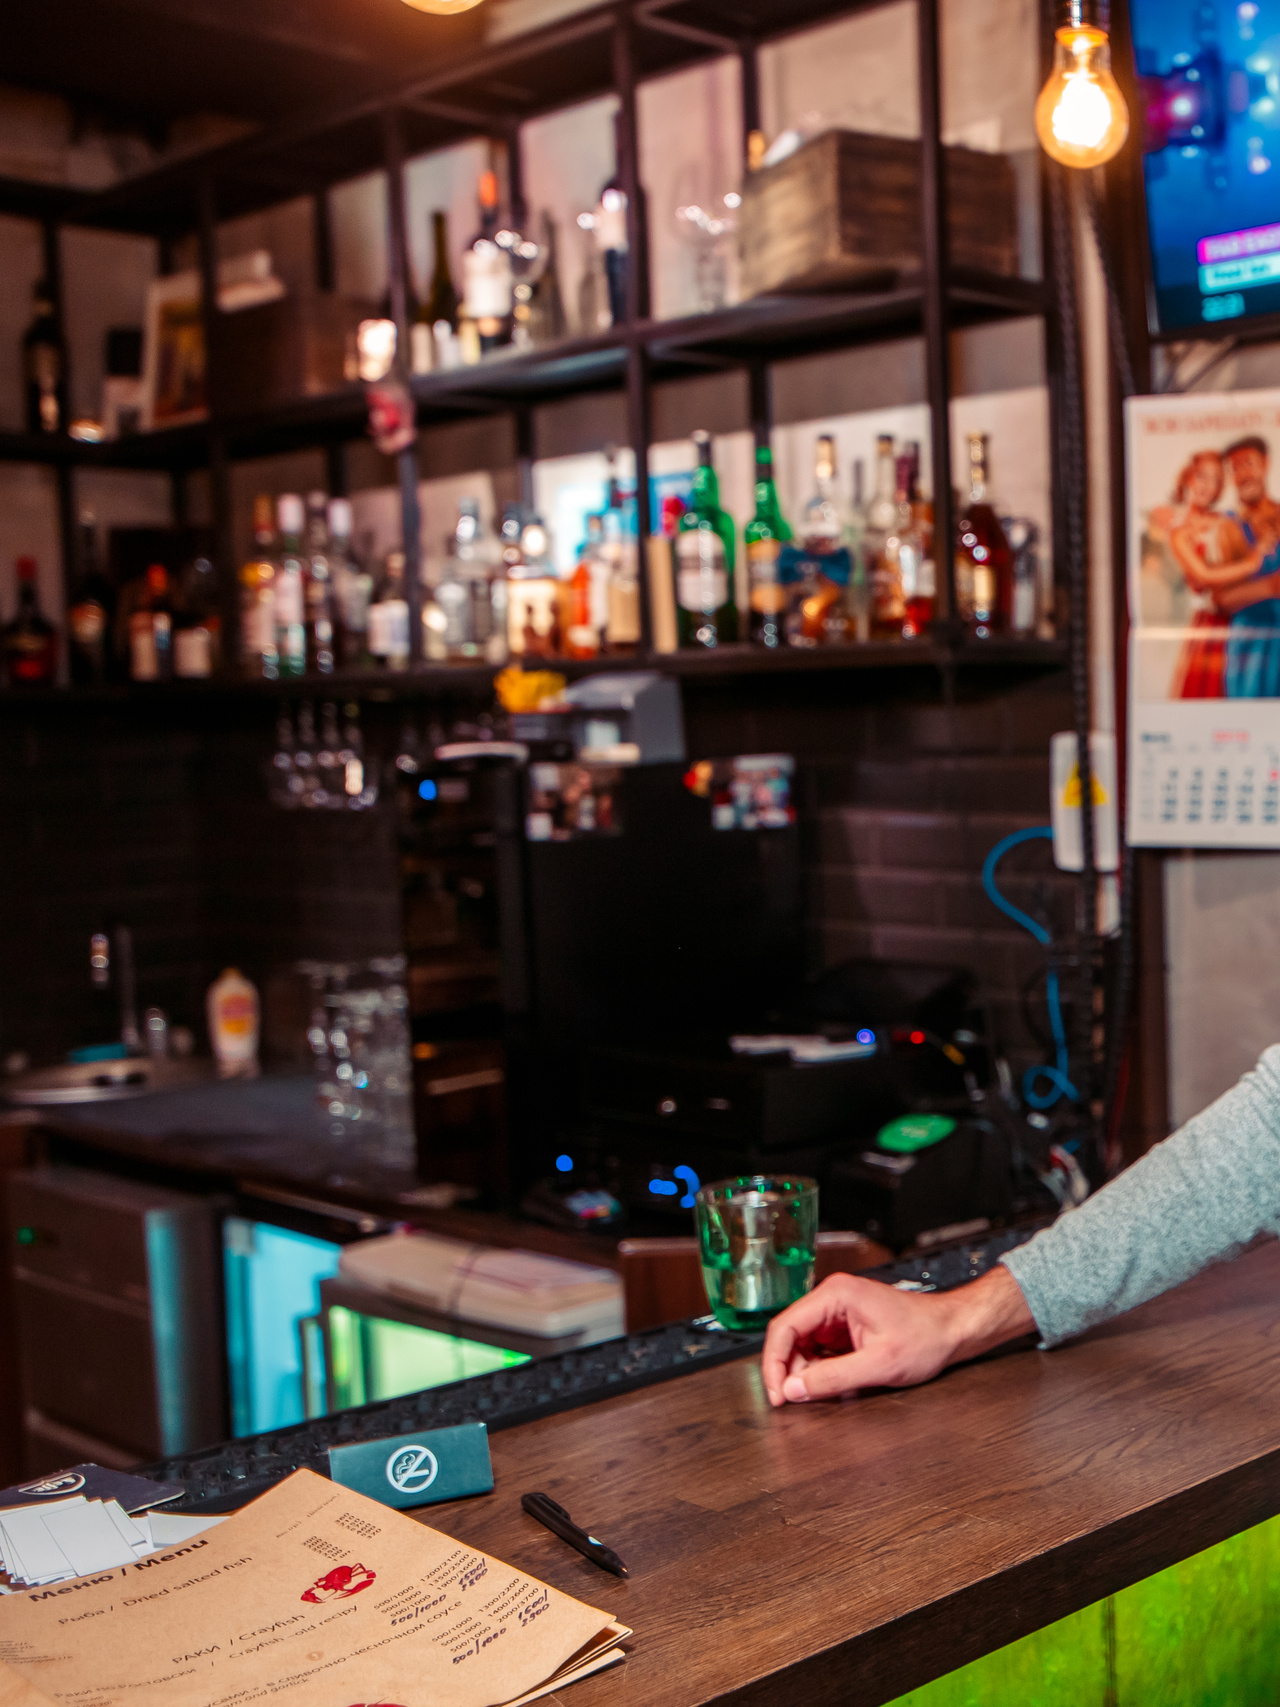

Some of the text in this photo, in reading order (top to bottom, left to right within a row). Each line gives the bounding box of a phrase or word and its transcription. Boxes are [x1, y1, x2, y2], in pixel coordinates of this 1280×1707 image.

[28, 1574, 114, 1602] Меню
[133, 1539, 209, 1571] Menu
[58, 1609, 105, 1625] Рыба
[123, 1588, 170, 1607] Dried
[173, 1569, 221, 1591] salted
[223, 1557, 253, 1571] fish
[373, 1550, 462, 1610] 500/1000 1200/2100
[381, 1553, 470, 1614] 500/1000 1350/2500
[390, 1557, 478, 1618] 500/1000 1900/3600
[172, 1645, 221, 1664] РАКИ
[238, 1614, 306, 1641] Crayfish
[229, 1636, 285, 1659] Crayfish
[318, 1605, 358, 1626] recipy
[426, 1601, 463, 1624] соусе
[431, 1578, 520, 1643] 500/1000 1300/2200
[441, 1582, 530, 1647] 500/1000 1400/2600
[450, 1587, 539, 1653] 500/1000 2000/3700
[244, 1690, 268, 1701] and
